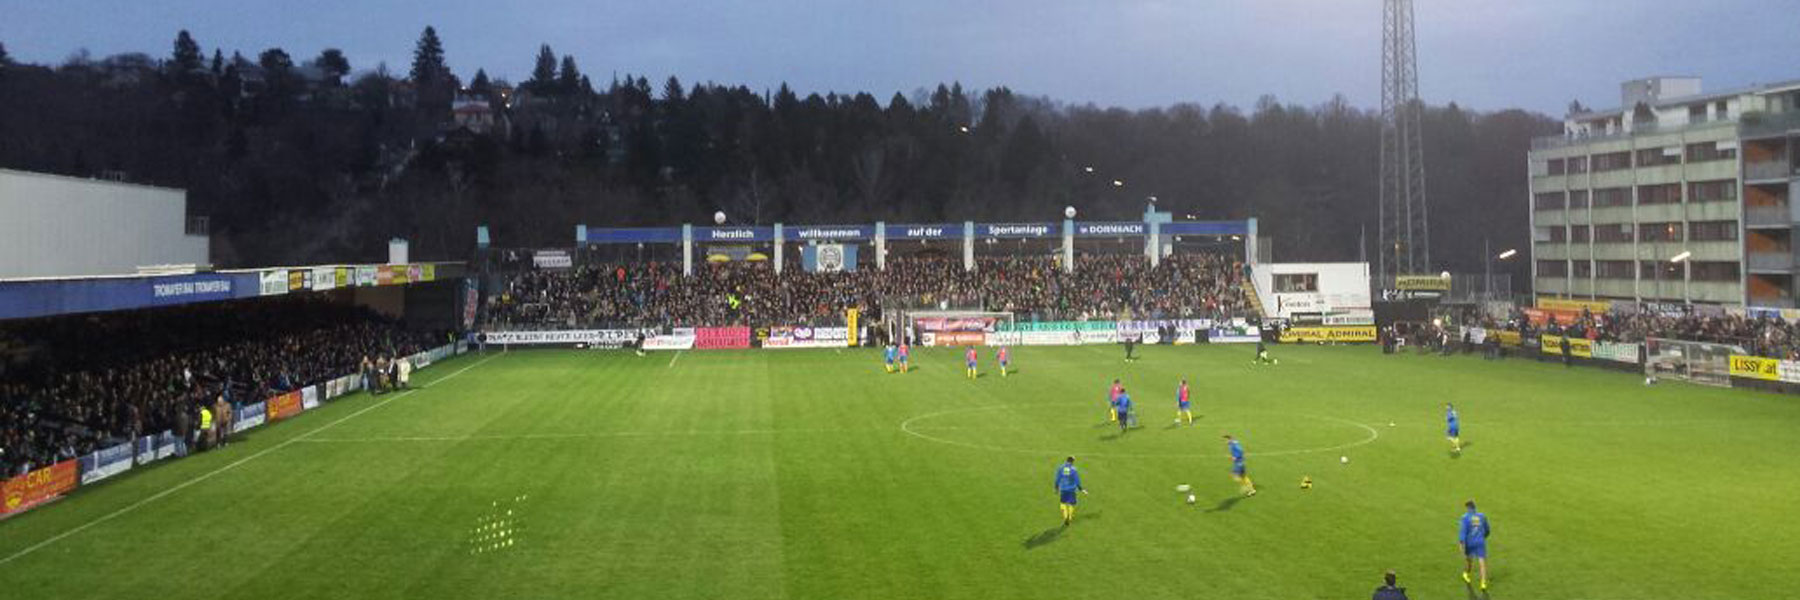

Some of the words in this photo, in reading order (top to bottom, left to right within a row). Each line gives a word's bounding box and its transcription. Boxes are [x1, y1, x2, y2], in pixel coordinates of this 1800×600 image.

[712, 229, 754, 239] Herzlich
[798, 229, 861, 238] willkommen
[907, 227, 924, 237] auf
[925, 227, 943, 237] der
[988, 226, 1048, 236] Sportanlage
[1326, 329, 1375, 338] ADMIRAL
[26, 467, 51, 488] CAR
